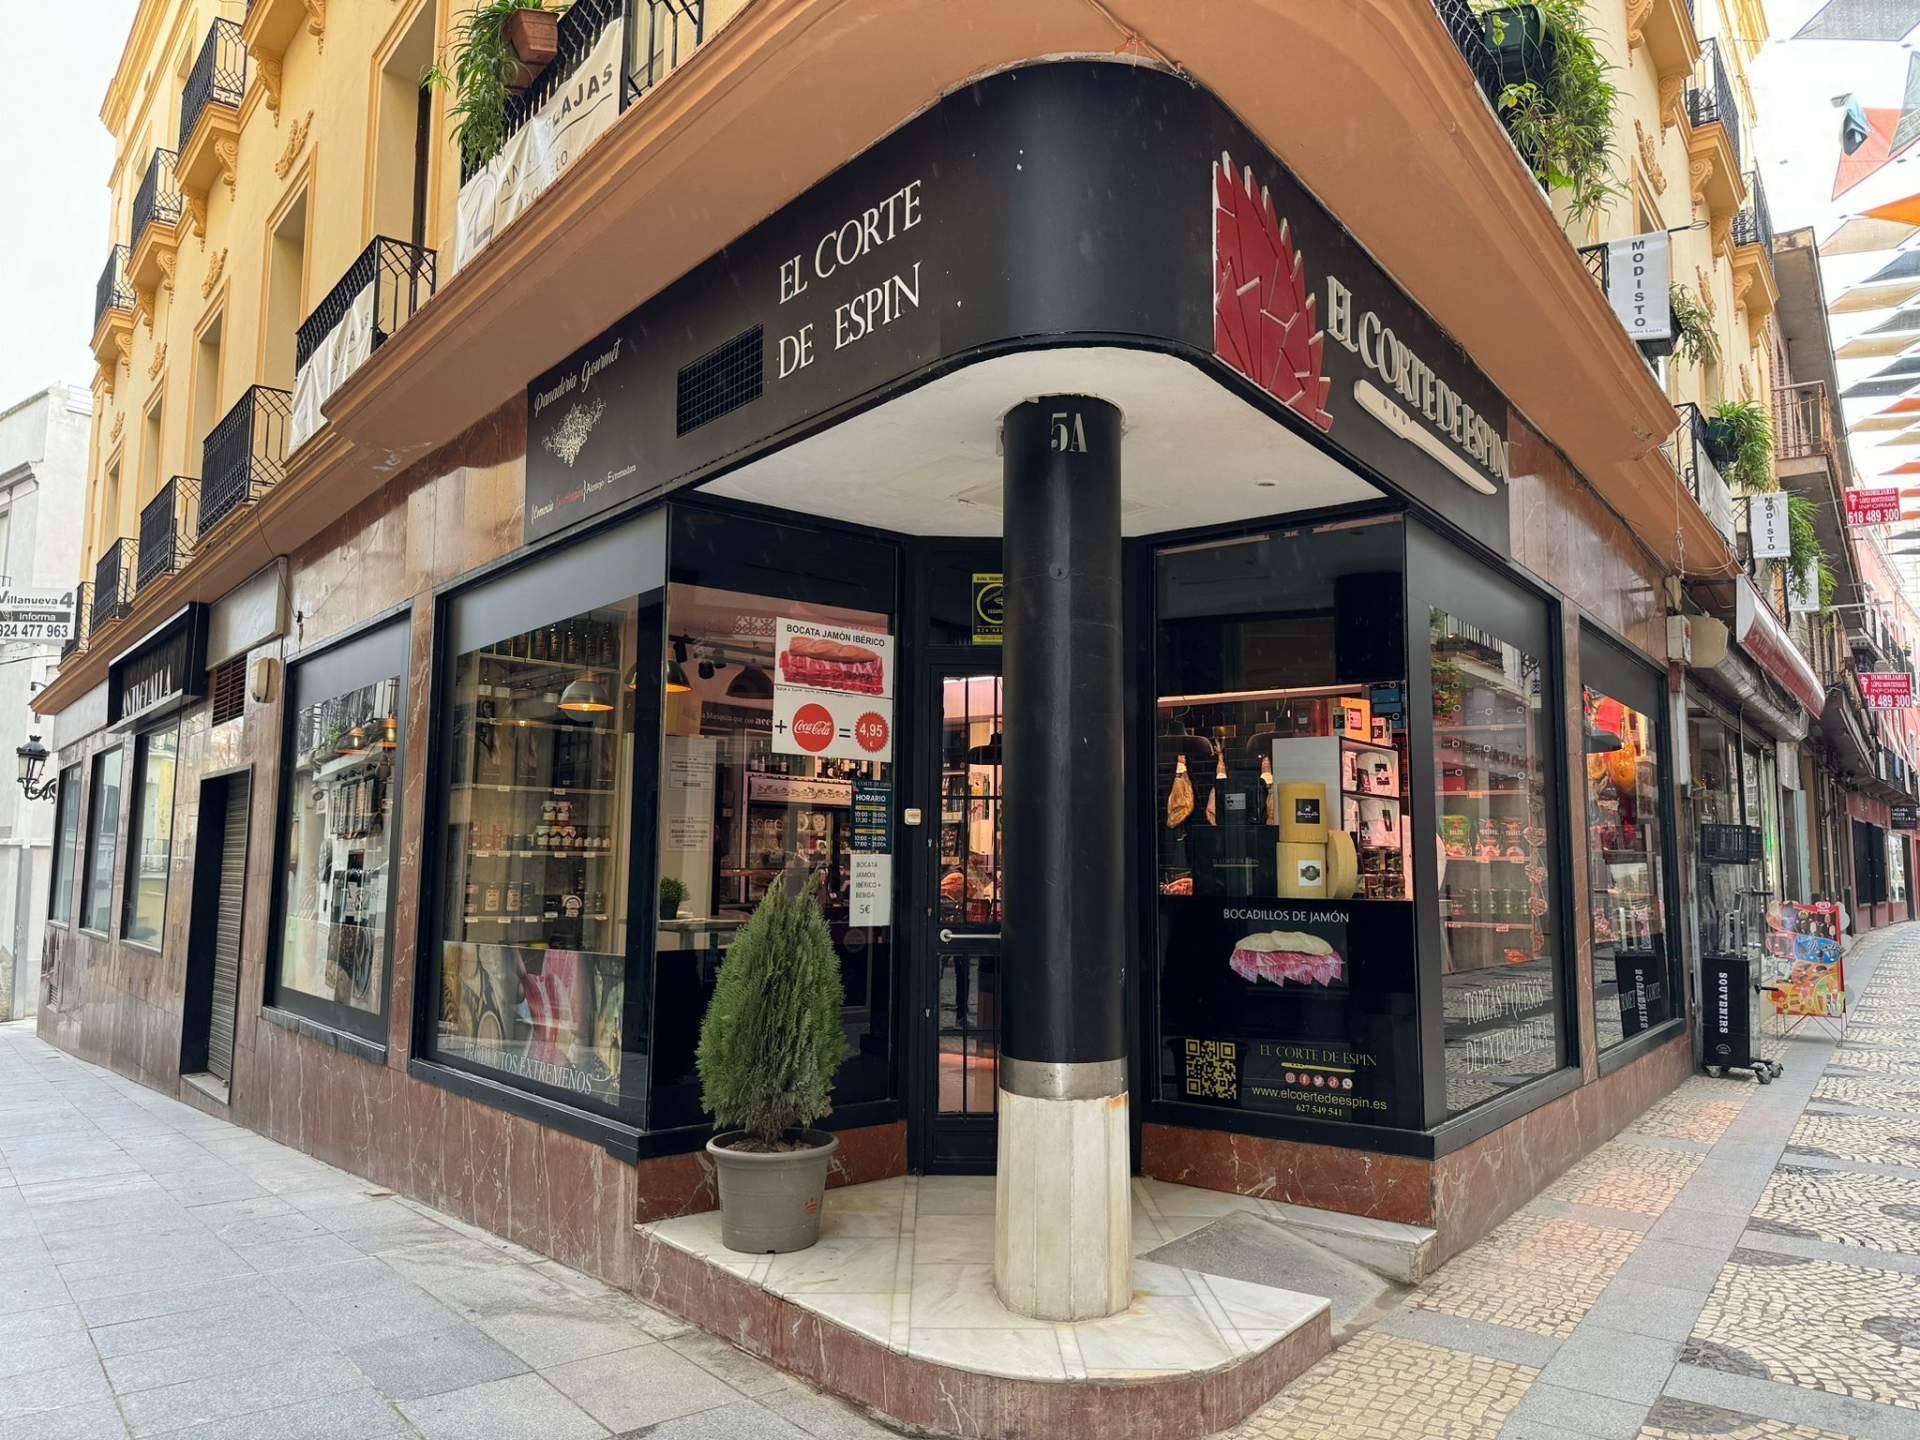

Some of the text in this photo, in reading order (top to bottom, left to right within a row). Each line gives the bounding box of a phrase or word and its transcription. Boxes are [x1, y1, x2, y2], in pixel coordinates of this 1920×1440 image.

[779, 179, 922, 304] EL CORTE
[1631, 240, 1646, 327] MODISTO
[778, 261, 921, 379] DE ESPIN
[581, 337, 623, 393] Gourmet
[1327, 276, 1509, 484] EL CORTE DE ESPIN
[1050, 412, 1088, 453] 5A
[1849, 508, 1899, 524] 618 489 300
[0, 590, 74, 608] Villanueva 4
[20, 612, 56, 621] Informa
[21, 623, 43, 638] 477
[46, 624, 68, 638] 963
[786, 623, 885, 647] BOCATA JAMÓN IBÉRICO
[1877, 694, 1893, 707] 489
[1894, 694, 1910, 707] 300
[859, 723, 883, 738] 4,95
[856, 794, 886, 802] HORARIO
[856, 880, 876, 888] IBÉRICO
[859, 904, 871, 914] 5€
[1223, 908, 1350, 923] BOCADILLOS DE JAMÓN
[1464, 979, 1544, 1025] TORTAS Y QUESOS
[1718, 972, 1728, 1034] SOUVENIRS
[1259, 1044, 1377, 1067] EL CORTE DE ESPIN
[1465, 1019, 1548, 1075] DE EXTREMADURA
[464, 1043, 594, 1095] PRODUCTOS EXTREMEÑOS
[1251, 1087, 1388, 1111] www.elcoertedeespin.es
[1296, 1104, 1342, 1117] 627 549 541
